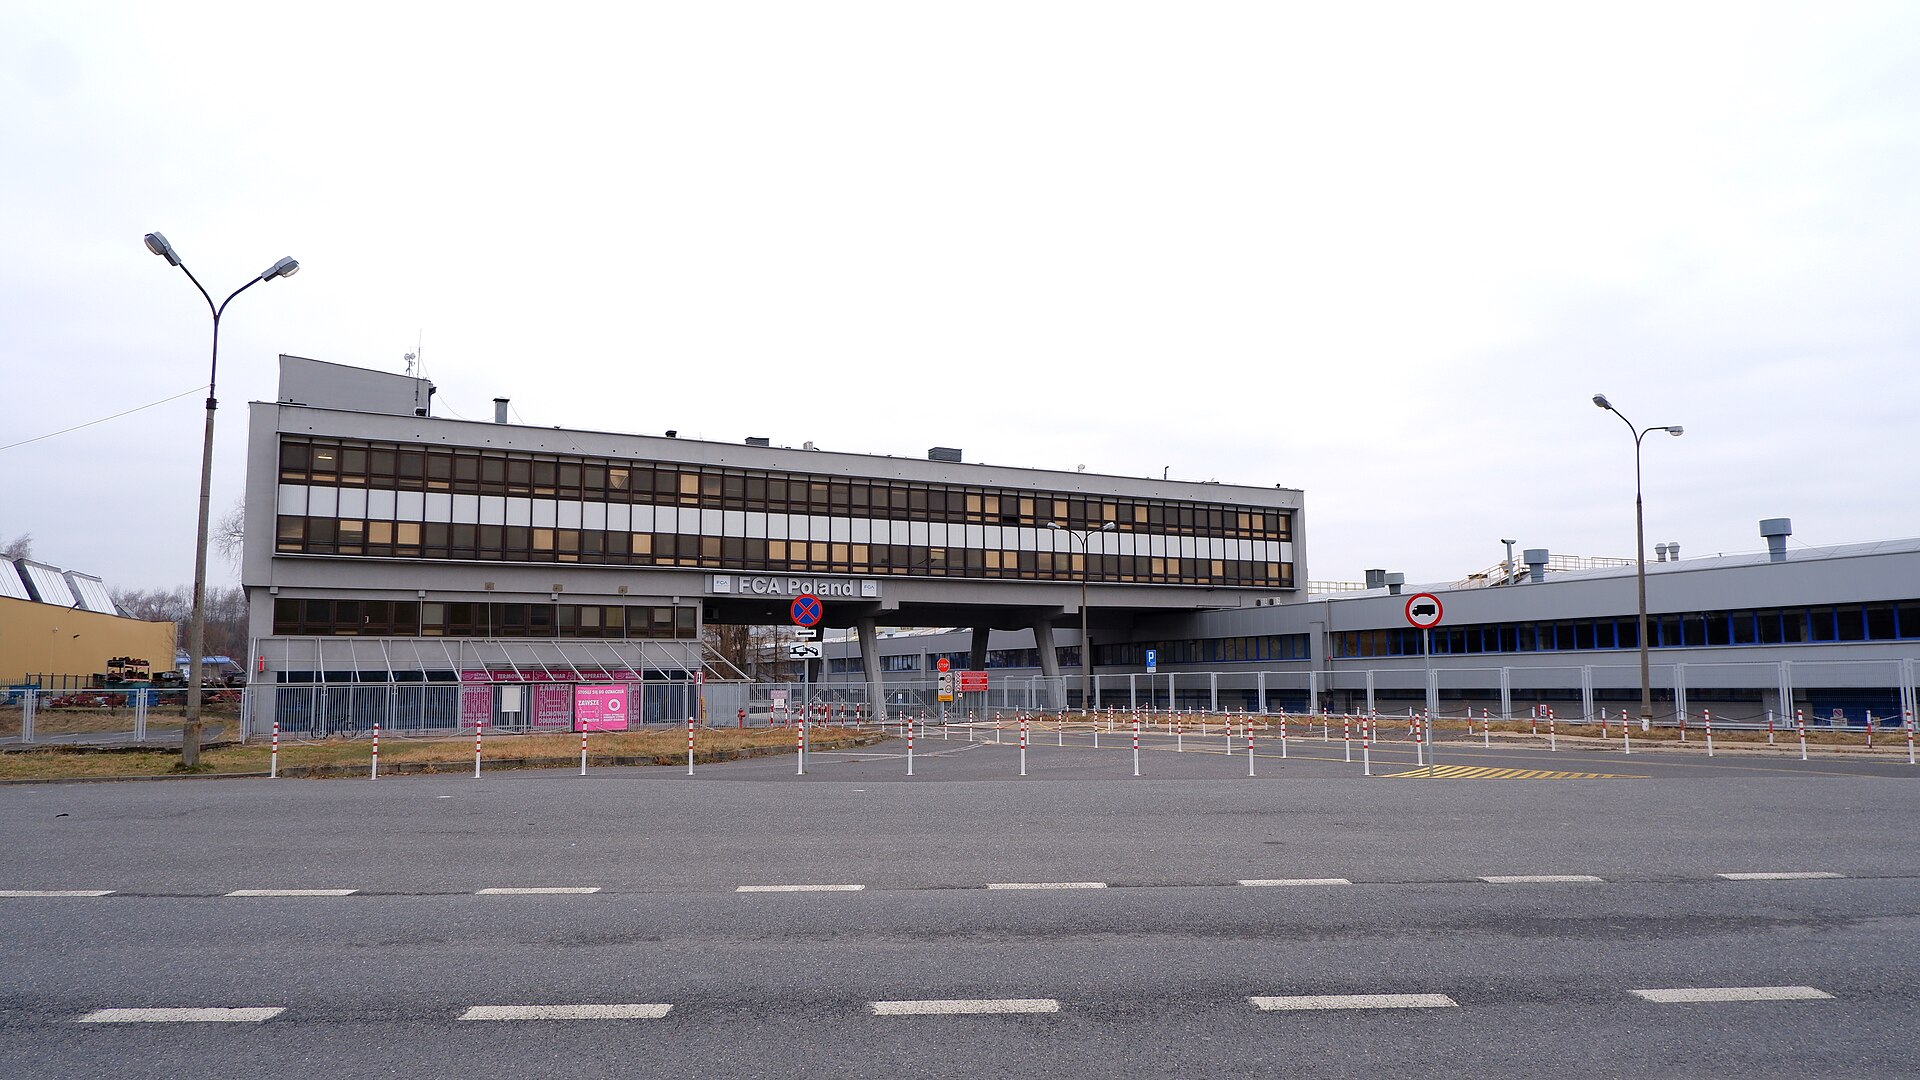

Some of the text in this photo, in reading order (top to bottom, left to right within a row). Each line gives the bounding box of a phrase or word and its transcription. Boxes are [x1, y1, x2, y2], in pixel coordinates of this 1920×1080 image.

[739, 577, 853, 597] FCA Poland
[1148, 652, 1154, 662] P
